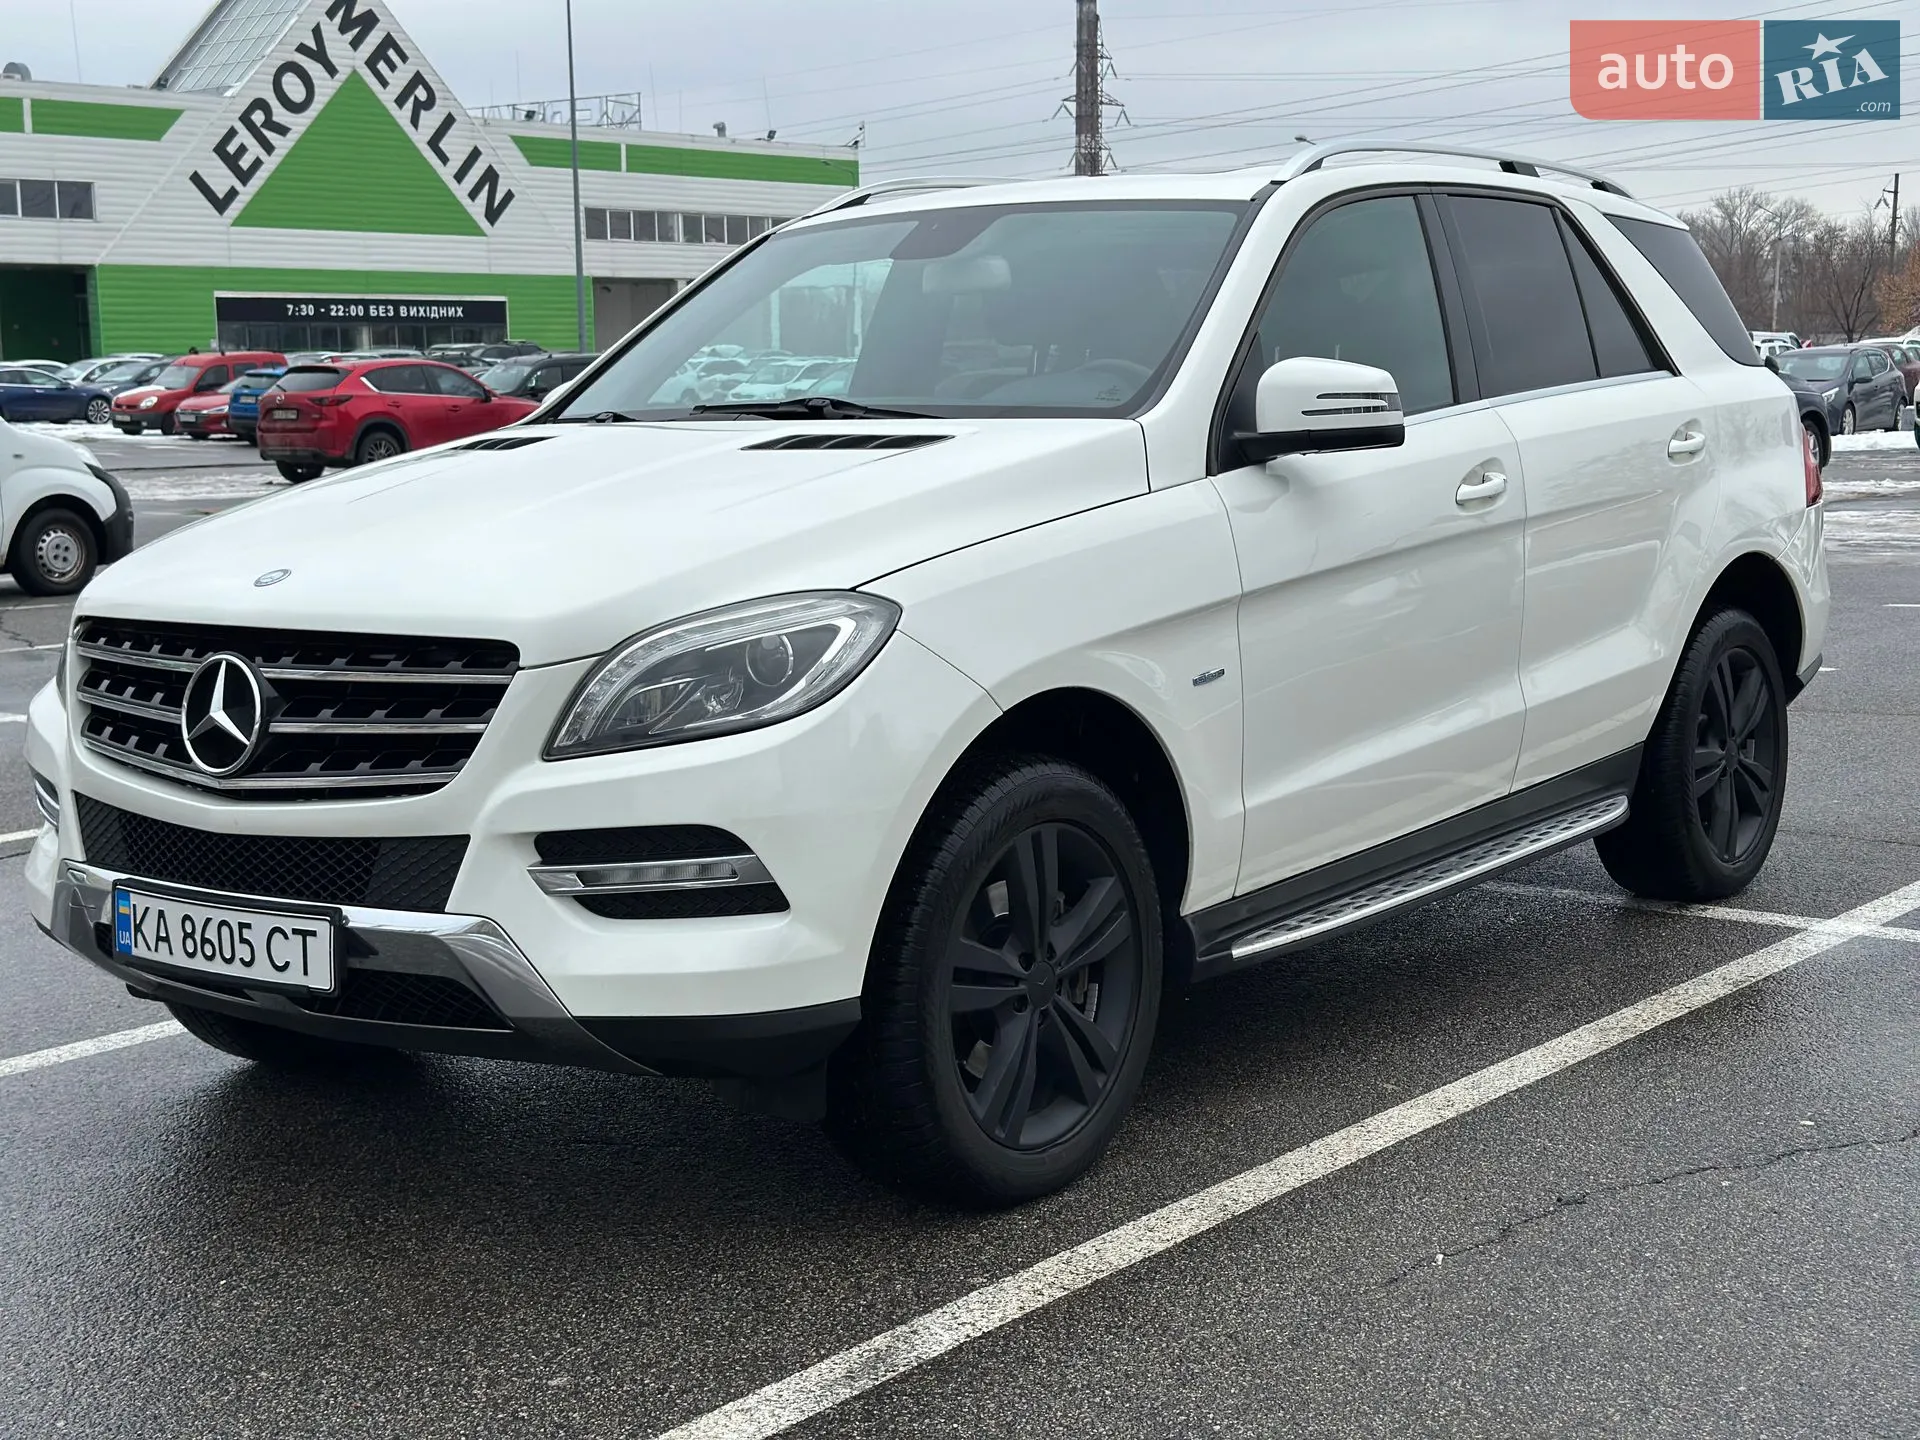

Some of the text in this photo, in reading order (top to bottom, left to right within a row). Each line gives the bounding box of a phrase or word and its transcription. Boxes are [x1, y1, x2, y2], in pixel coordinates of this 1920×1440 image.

[188, 0, 516, 228] LEROY MERLIN
[286, 304, 315, 317] 7:30
[330, 304, 365, 317] 22:00
[369, 305, 395, 318] БЕЗ
[400, 306, 464, 319] ВИХІДНИХ
[119, 931, 131, 946] UA
[132, 903, 318, 977] KA 8605 CT
